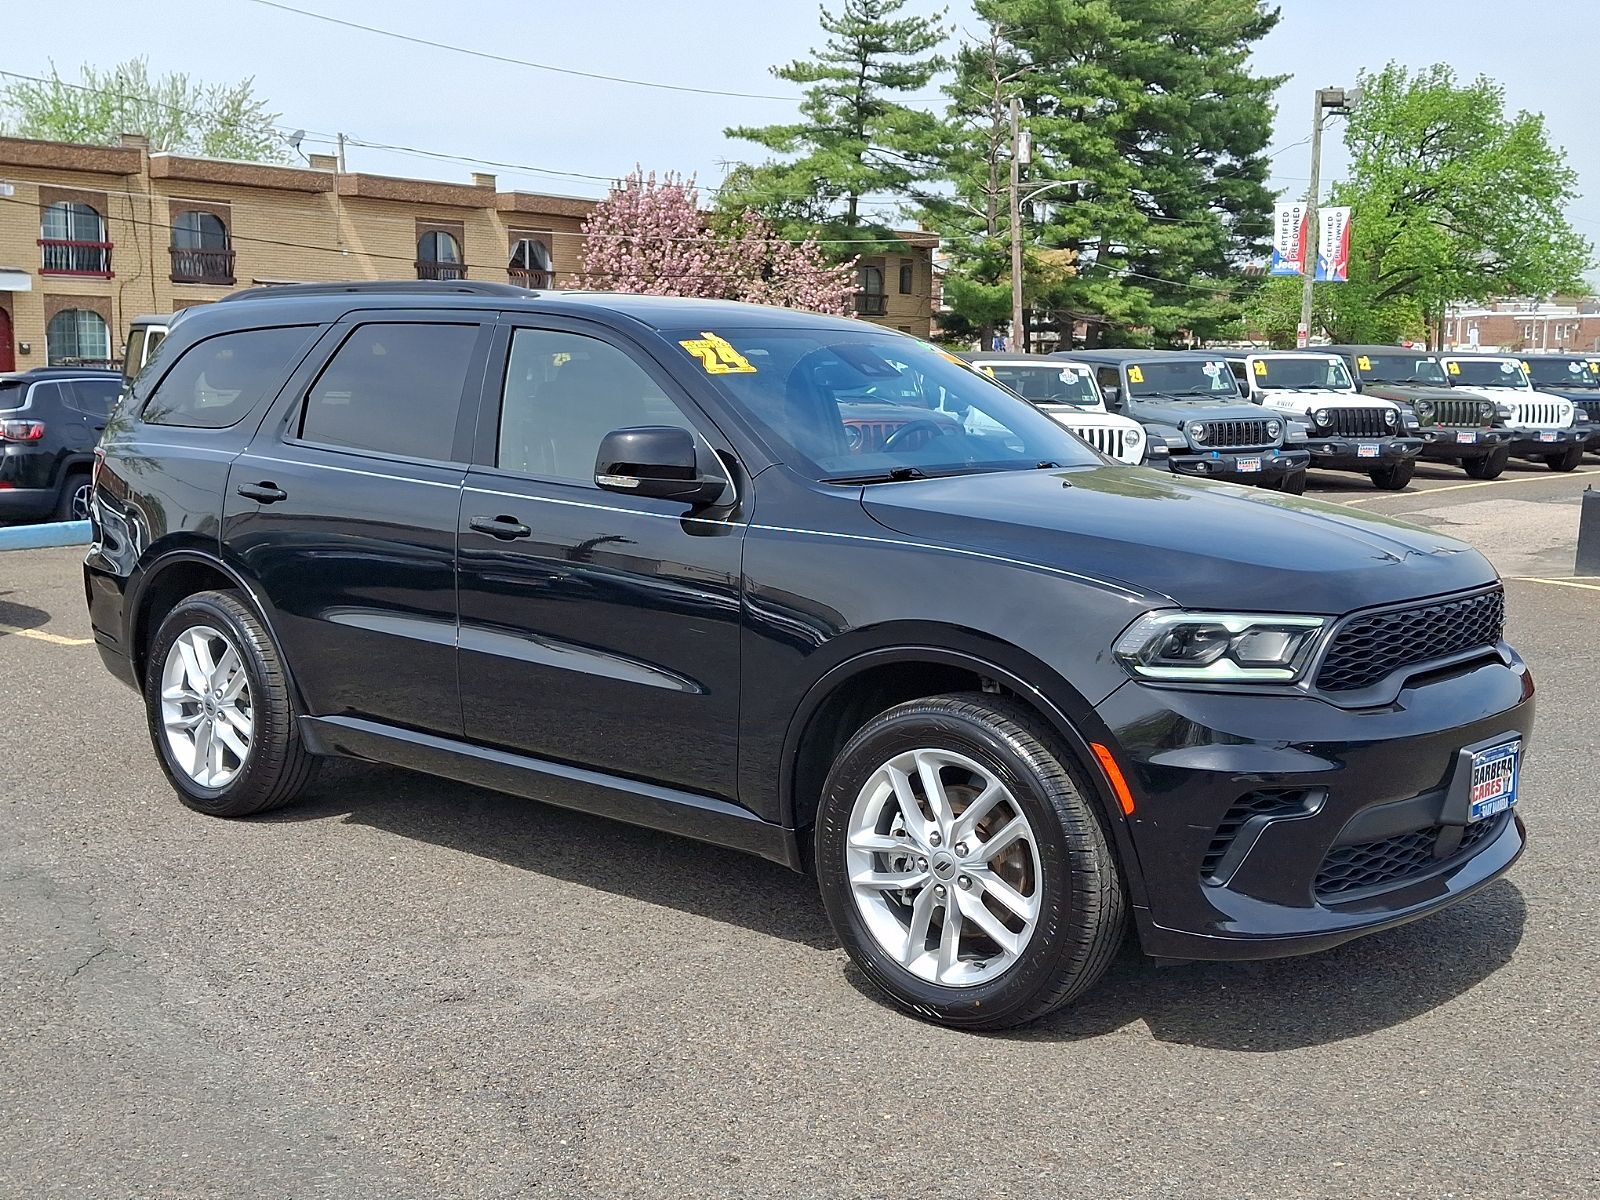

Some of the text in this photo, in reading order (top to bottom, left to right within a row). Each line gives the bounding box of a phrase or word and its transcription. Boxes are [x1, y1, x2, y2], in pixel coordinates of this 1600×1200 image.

[1280, 211, 1290, 258] CERTIFIED
[1326, 216, 1334, 258] CERTIFIED
[1274, 259, 1301, 271] Jeep
[1473, 757, 1513, 787] BARBERA
[1472, 778, 1503, 803] CARES
